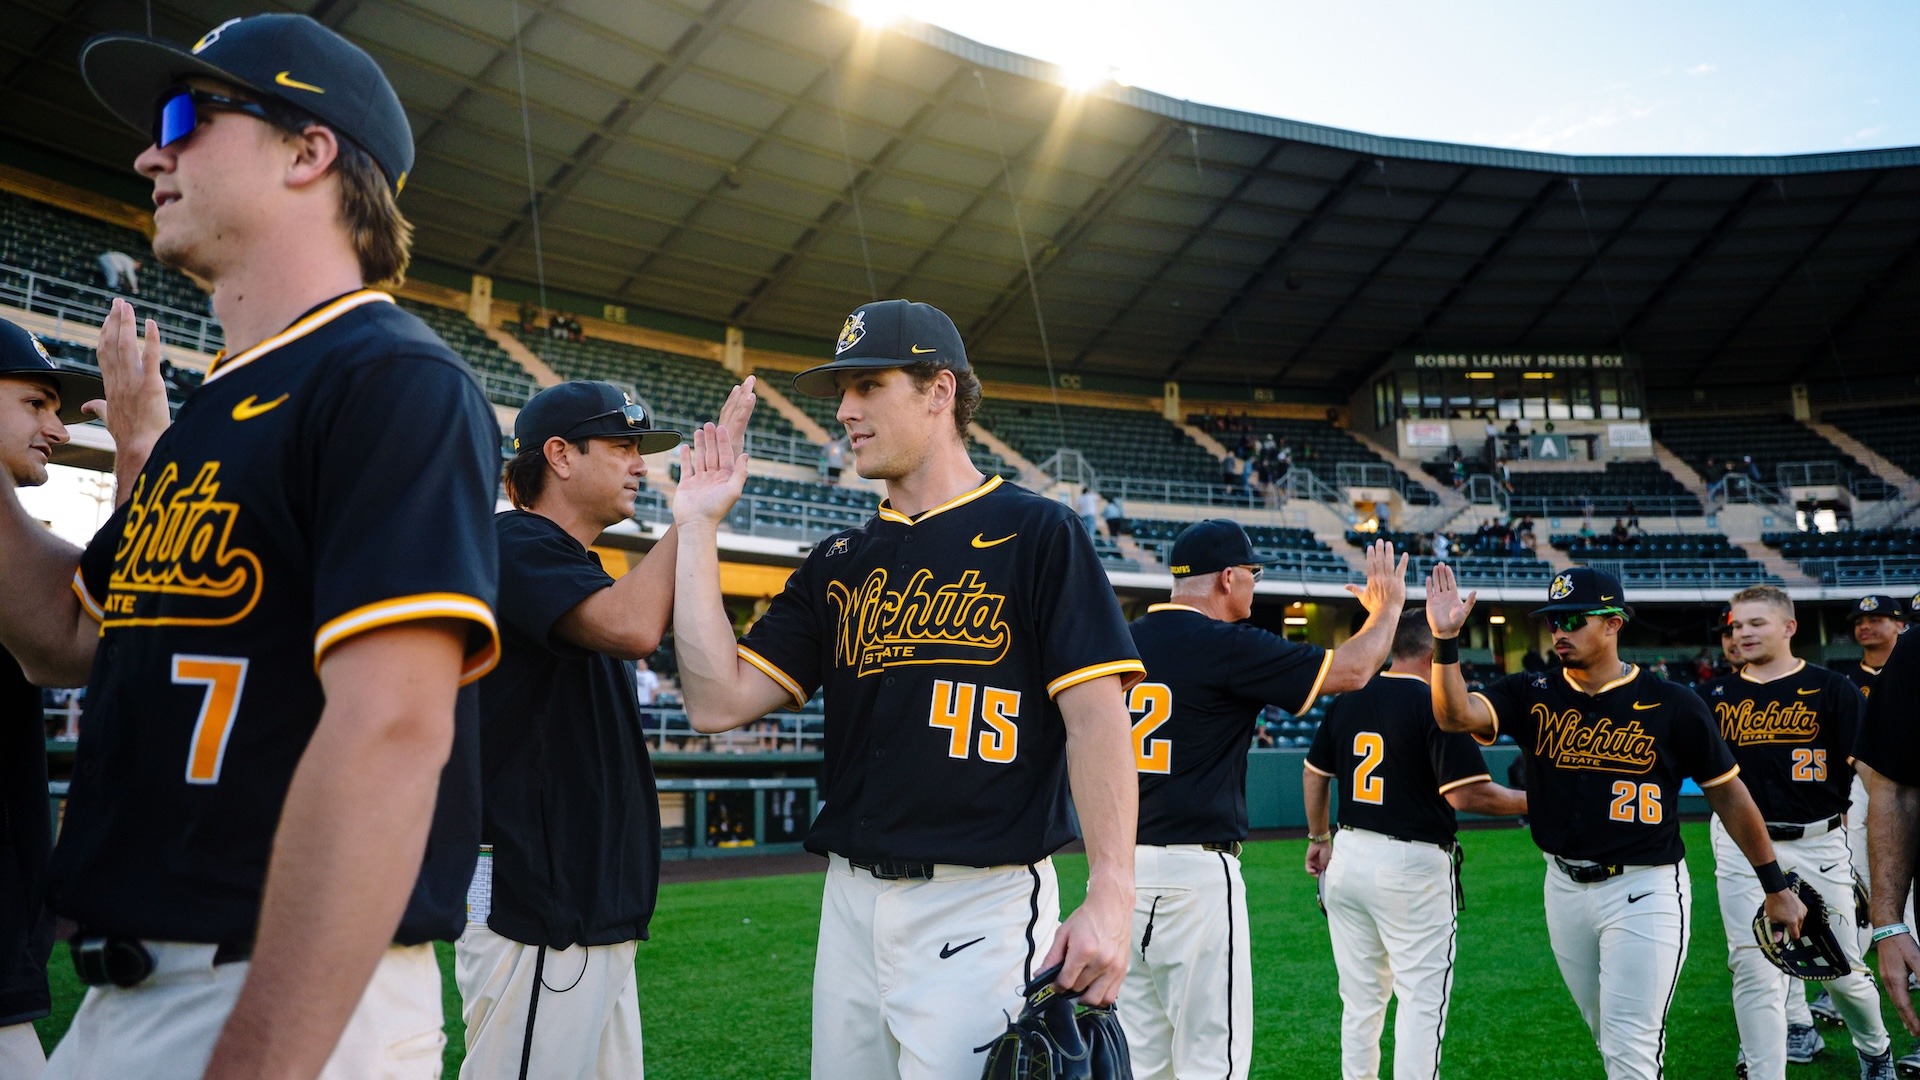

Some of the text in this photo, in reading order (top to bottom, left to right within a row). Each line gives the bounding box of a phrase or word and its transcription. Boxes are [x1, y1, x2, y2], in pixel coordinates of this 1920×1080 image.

[1472, 355, 1532, 367] LEAHEY
[1537, 355, 1587, 367] PRESS
[1592, 355, 1623, 367] BOX
[1539, 437, 1559, 457] A
[827, 567, 1011, 668] Wichita
[864, 646, 916, 665] STATE
[171, 653, 249, 785] 7
[929, 679, 1021, 764] 45
[1124, 682, 1172, 774] 2
[1530, 702, 1656, 772] Wichita
[1715, 698, 1820, 743] Wichita
[1743, 733, 1775, 741] STATE
[1352, 731, 1384, 805] 2
[1561, 754, 1602, 766] STATE
[1791, 747, 1828, 782] 25
[1609, 779, 1662, 825] 26
